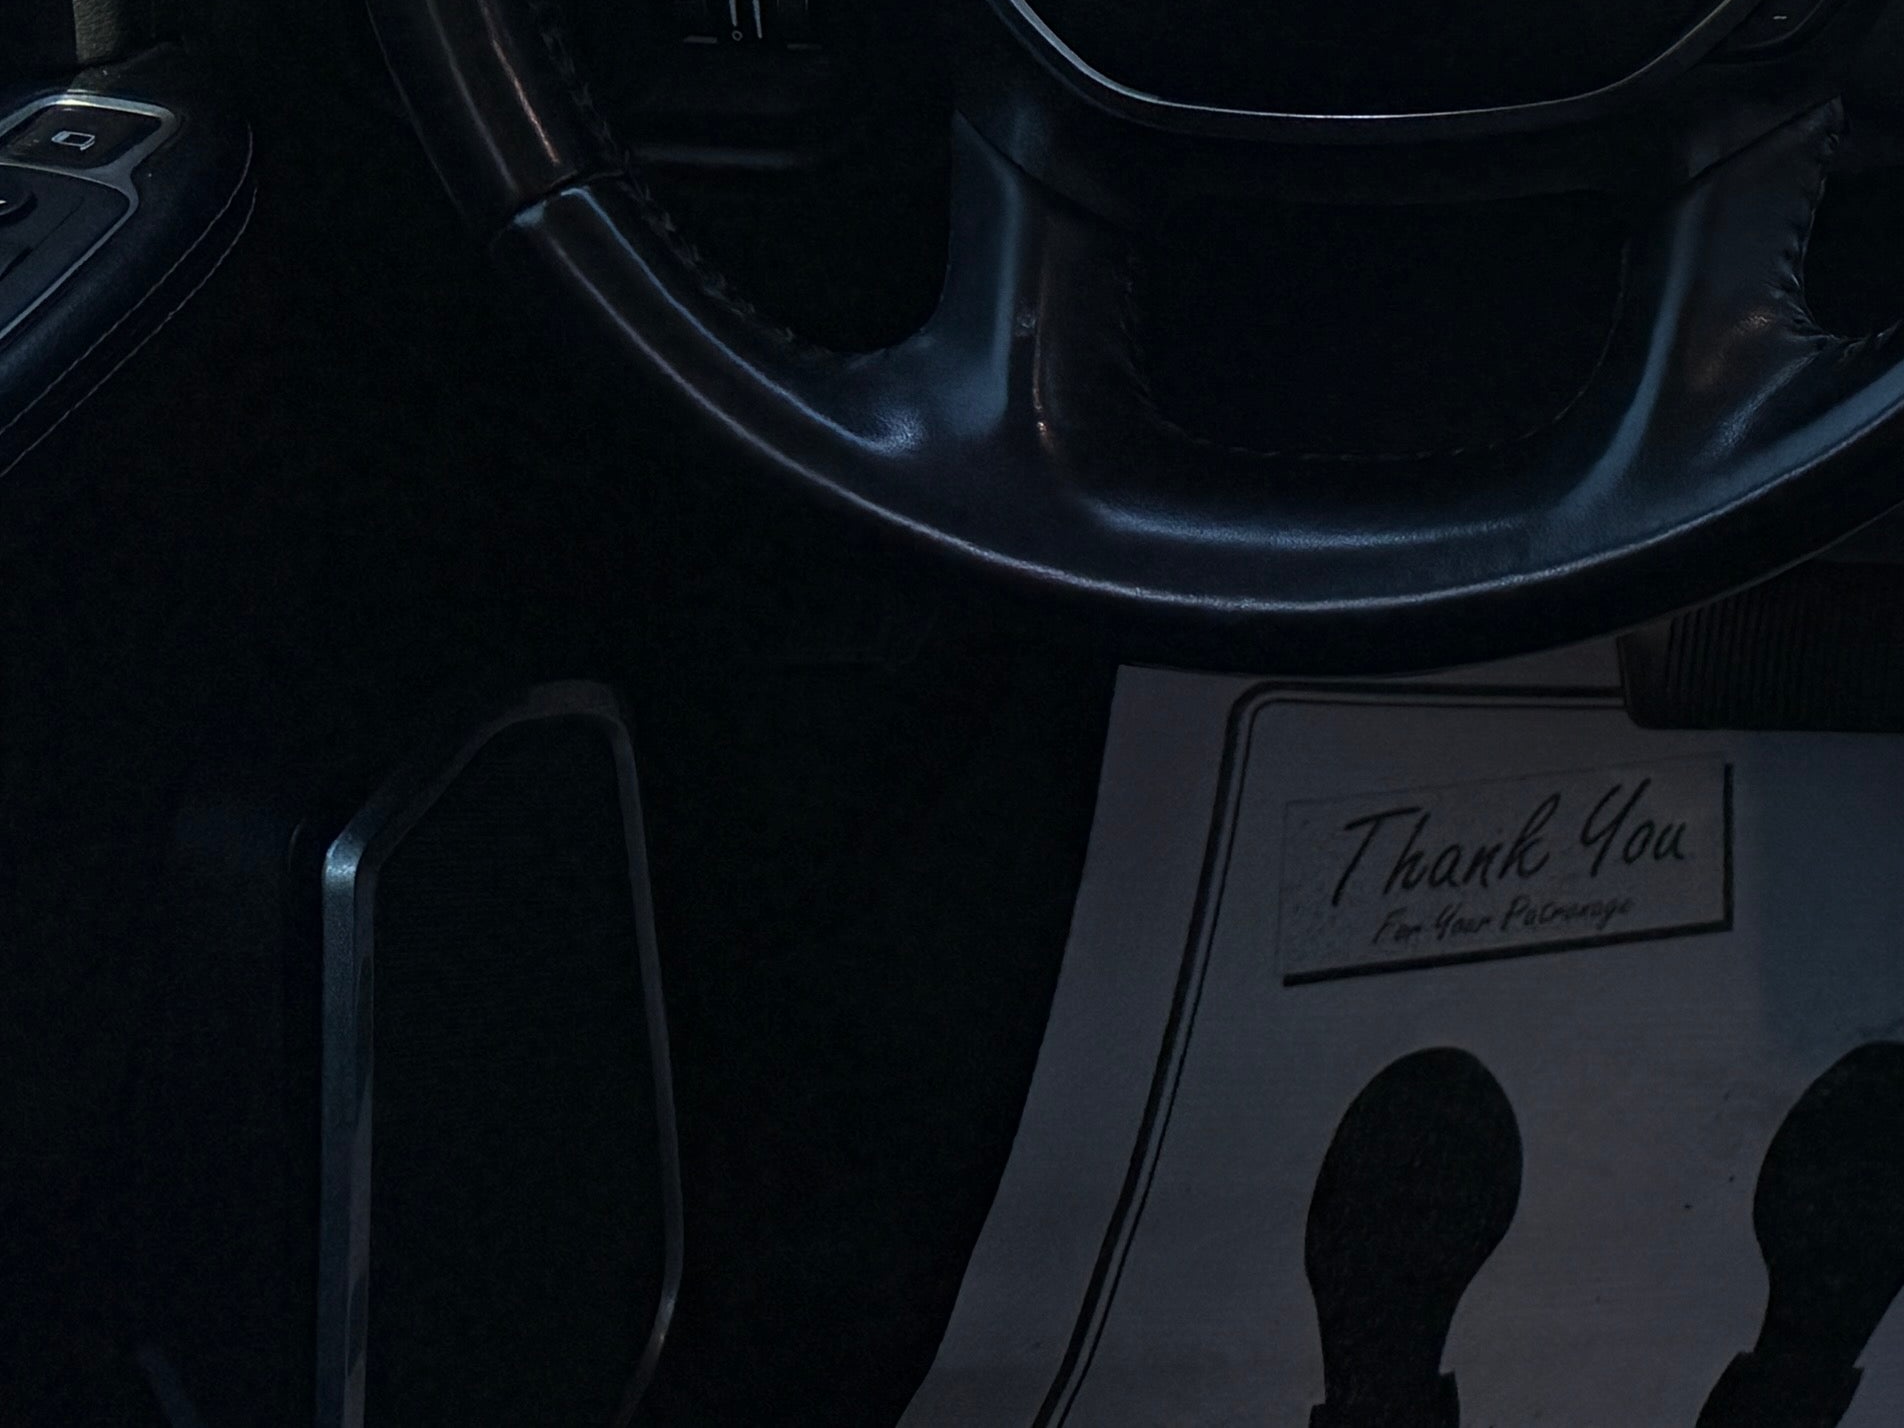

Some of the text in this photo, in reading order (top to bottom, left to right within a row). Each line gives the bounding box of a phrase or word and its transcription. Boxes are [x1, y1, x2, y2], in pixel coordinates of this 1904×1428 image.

[1330, 777, 1688, 907] Thank You
[1371, 907, 1422, 945] For
[1433, 903, 1493, 941] Your
